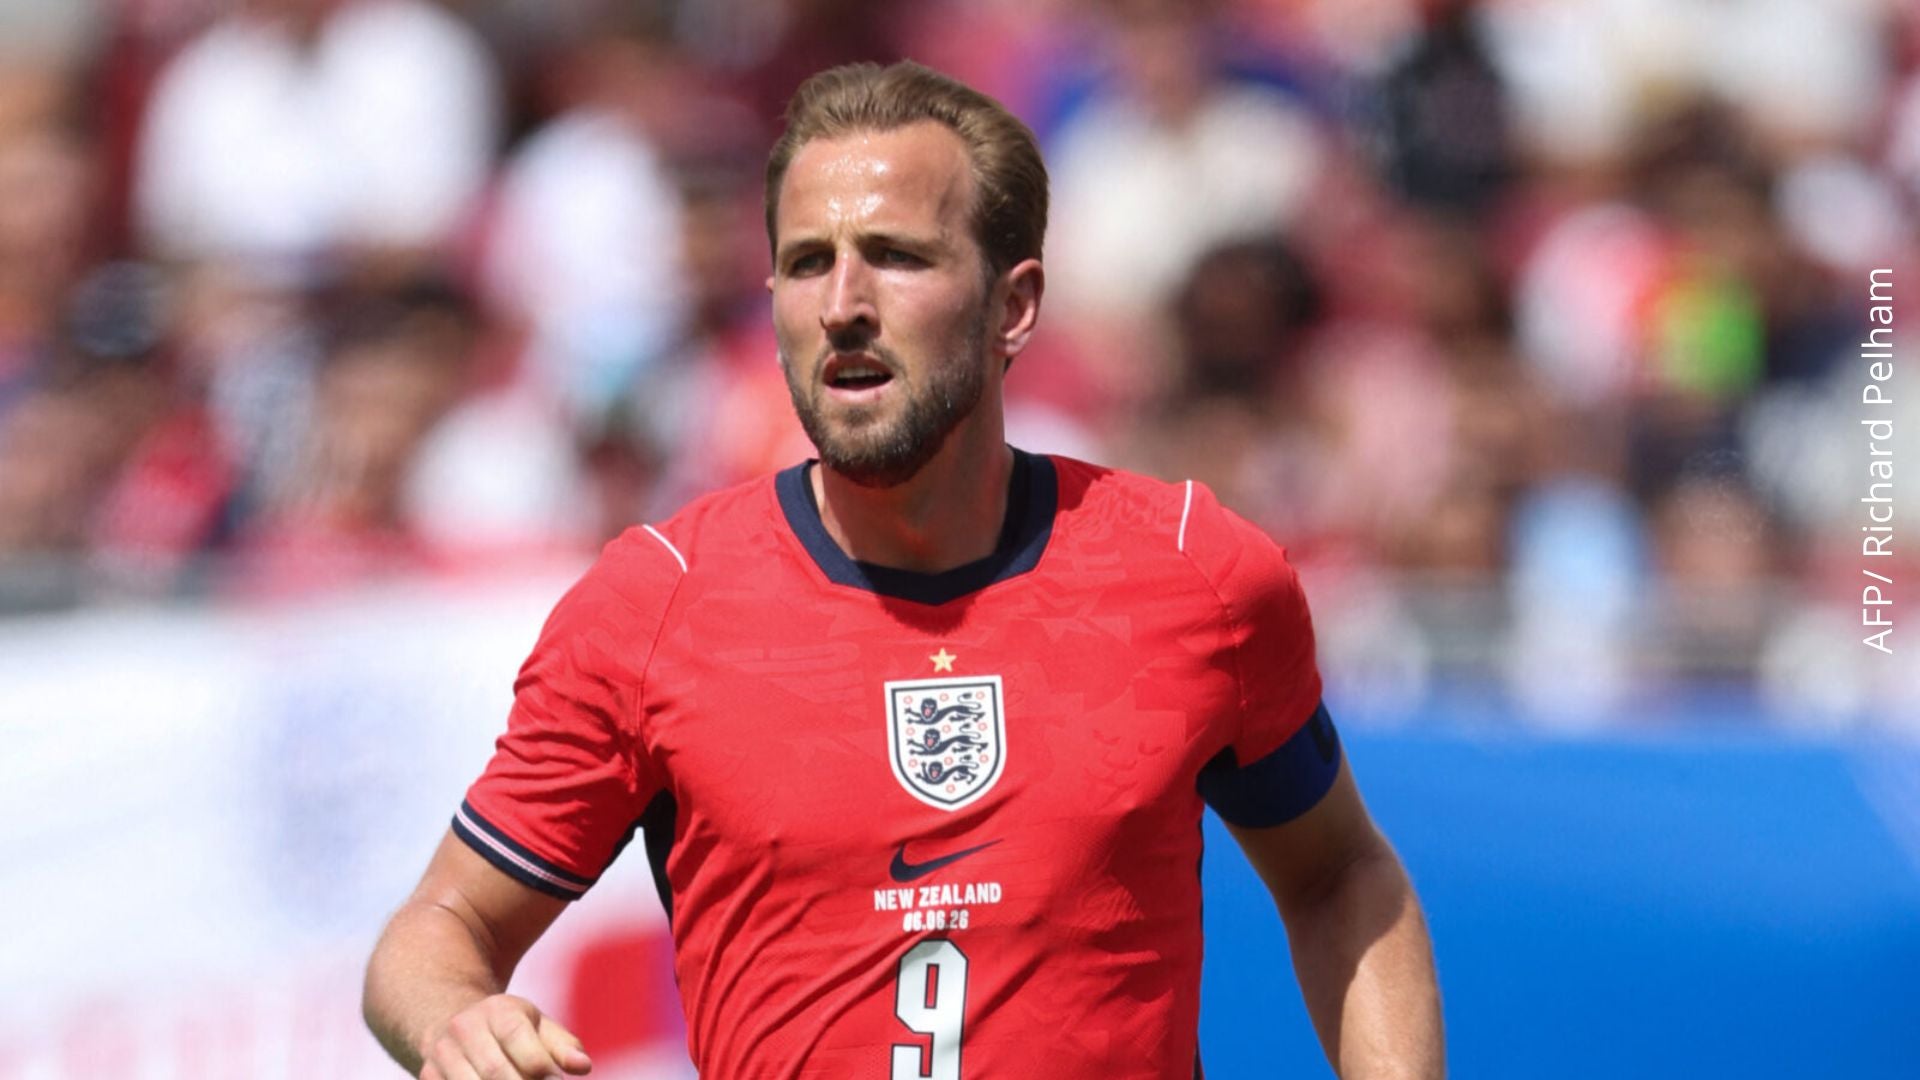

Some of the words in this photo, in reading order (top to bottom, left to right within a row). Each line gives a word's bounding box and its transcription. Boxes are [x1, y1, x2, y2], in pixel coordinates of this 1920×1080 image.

[874, 889, 914, 911] NEW
[919, 882, 1002, 906] ZEALAND
[903, 910, 968, 931] 06.06.26
[890, 938, 969, 1080] 9
